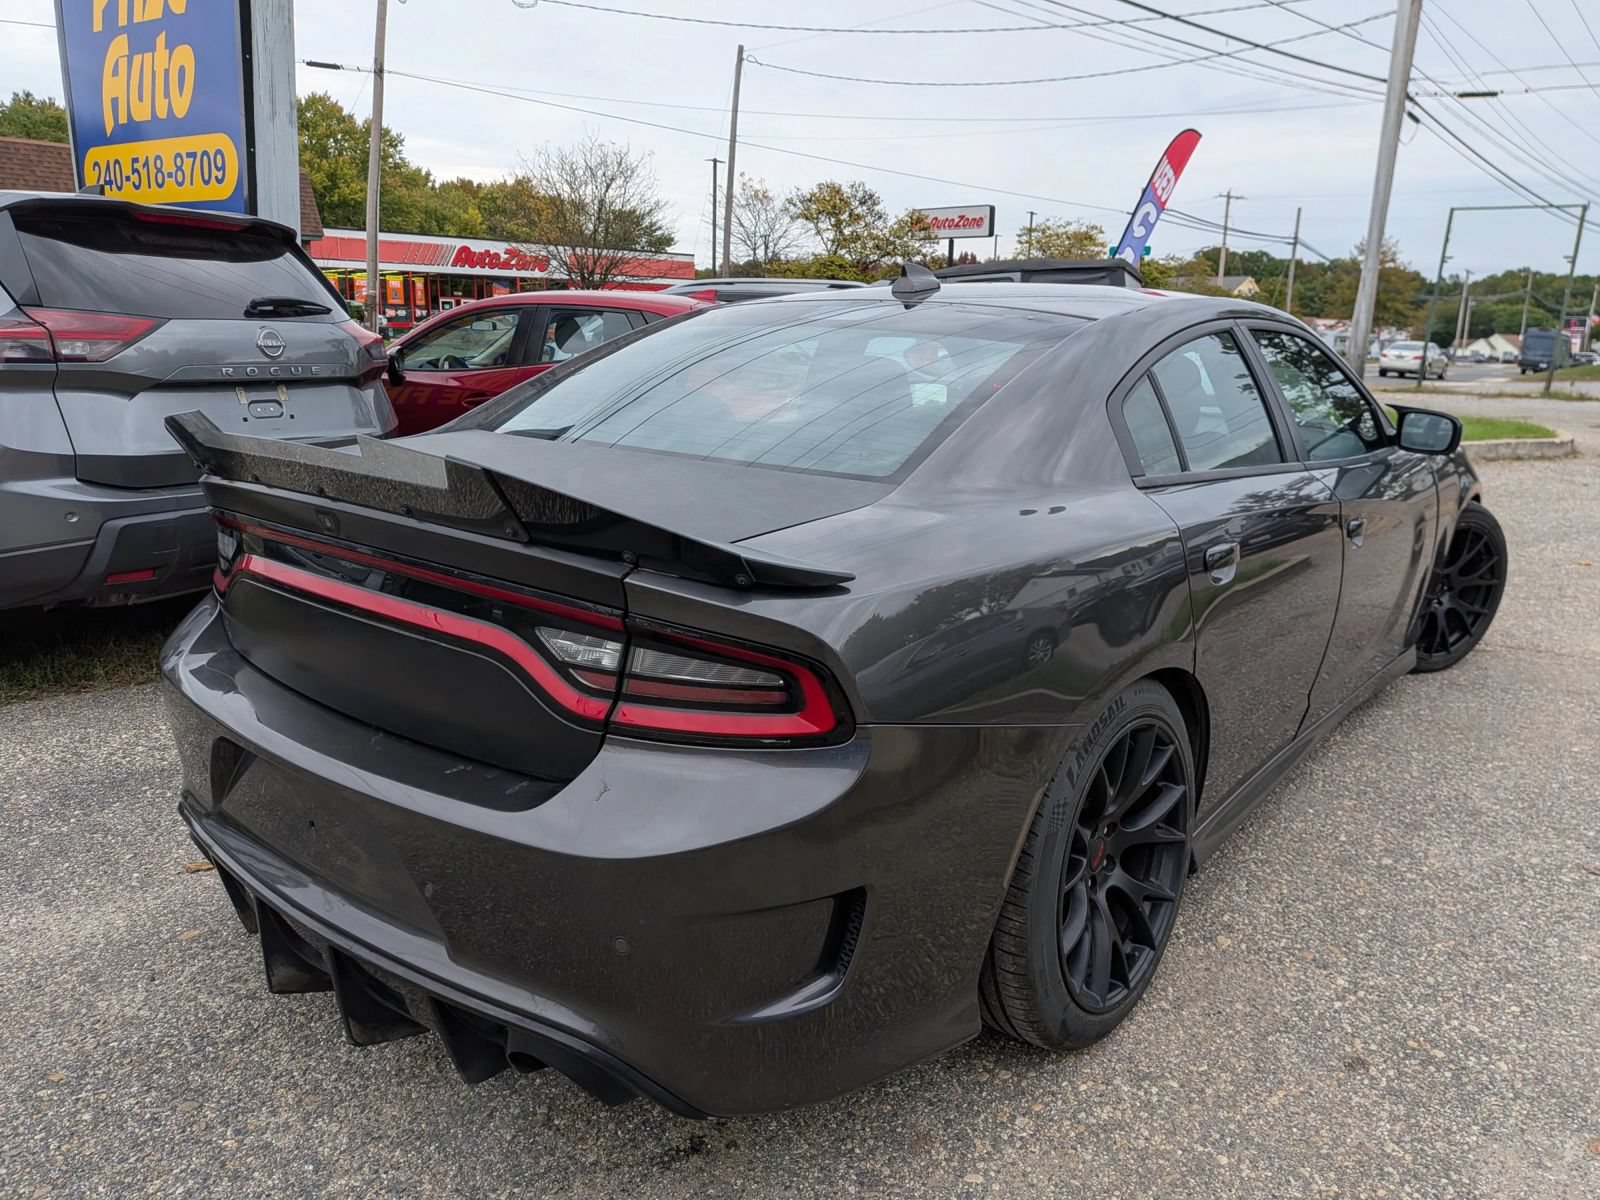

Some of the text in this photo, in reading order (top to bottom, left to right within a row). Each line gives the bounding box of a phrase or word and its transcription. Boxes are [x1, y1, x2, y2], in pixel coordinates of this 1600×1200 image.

[102, 30, 195, 138] Auto
[92, 148, 226, 192] 240-518-8709
[930, 215, 984, 230] AutoZone
[451, 245, 550, 272] AutoZone
[257, 337, 286, 347] NISSAN
[221, 366, 322, 378] ROGUE
[1066, 696, 1127, 790] LANDSAIL
